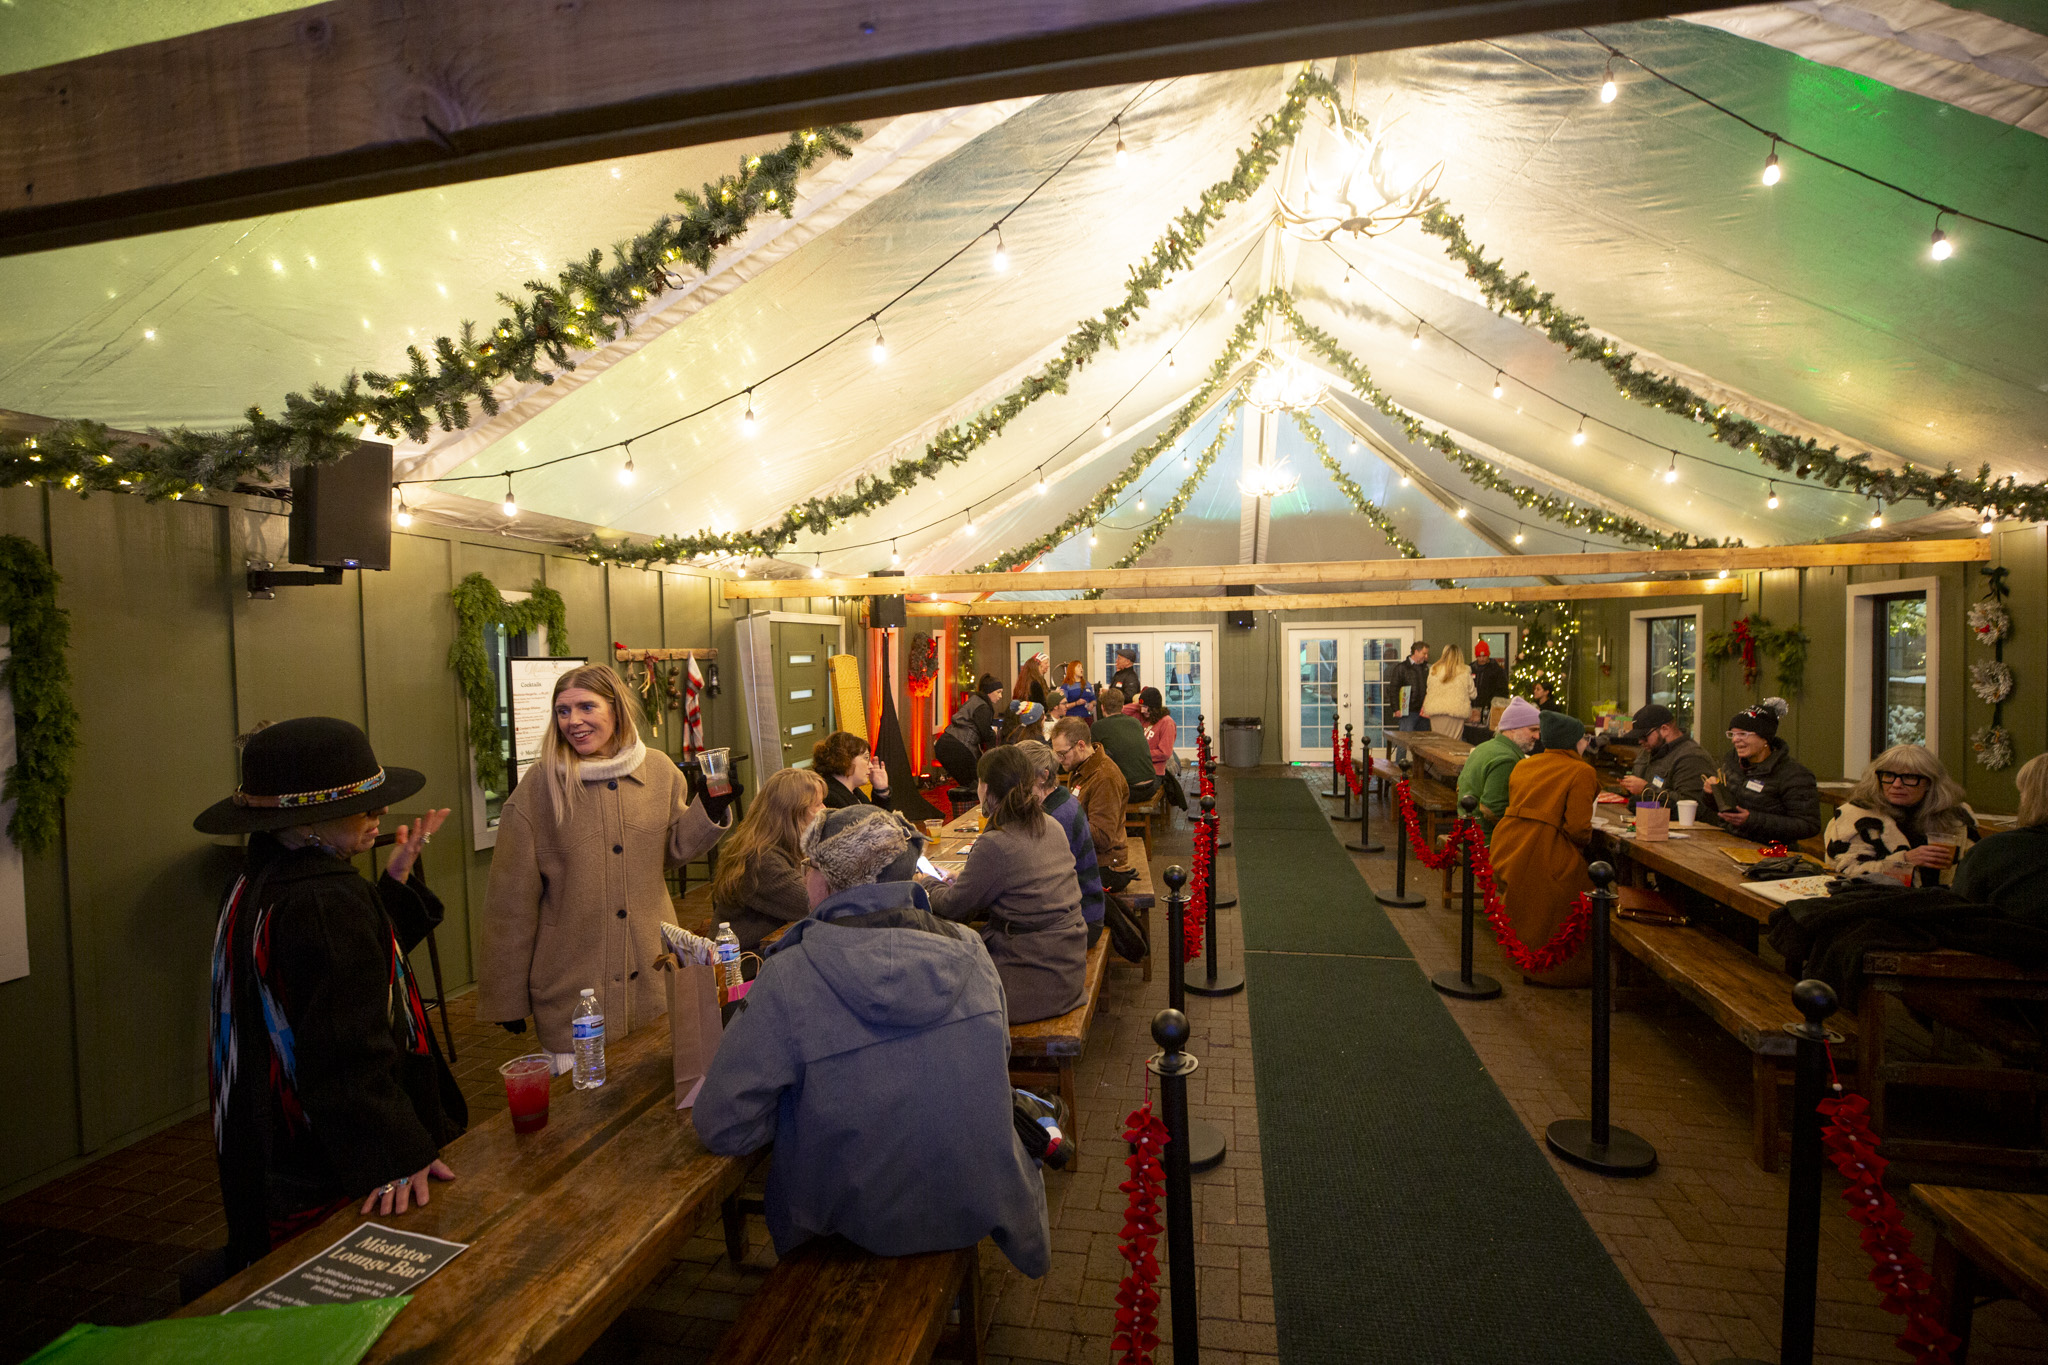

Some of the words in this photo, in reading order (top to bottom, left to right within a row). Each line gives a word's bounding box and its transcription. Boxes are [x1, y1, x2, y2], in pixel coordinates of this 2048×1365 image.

[328, 1246, 391, 1271] Lounge
[386, 1259, 427, 1279] Bar
[354, 1235, 433, 1264] Mistletoe
